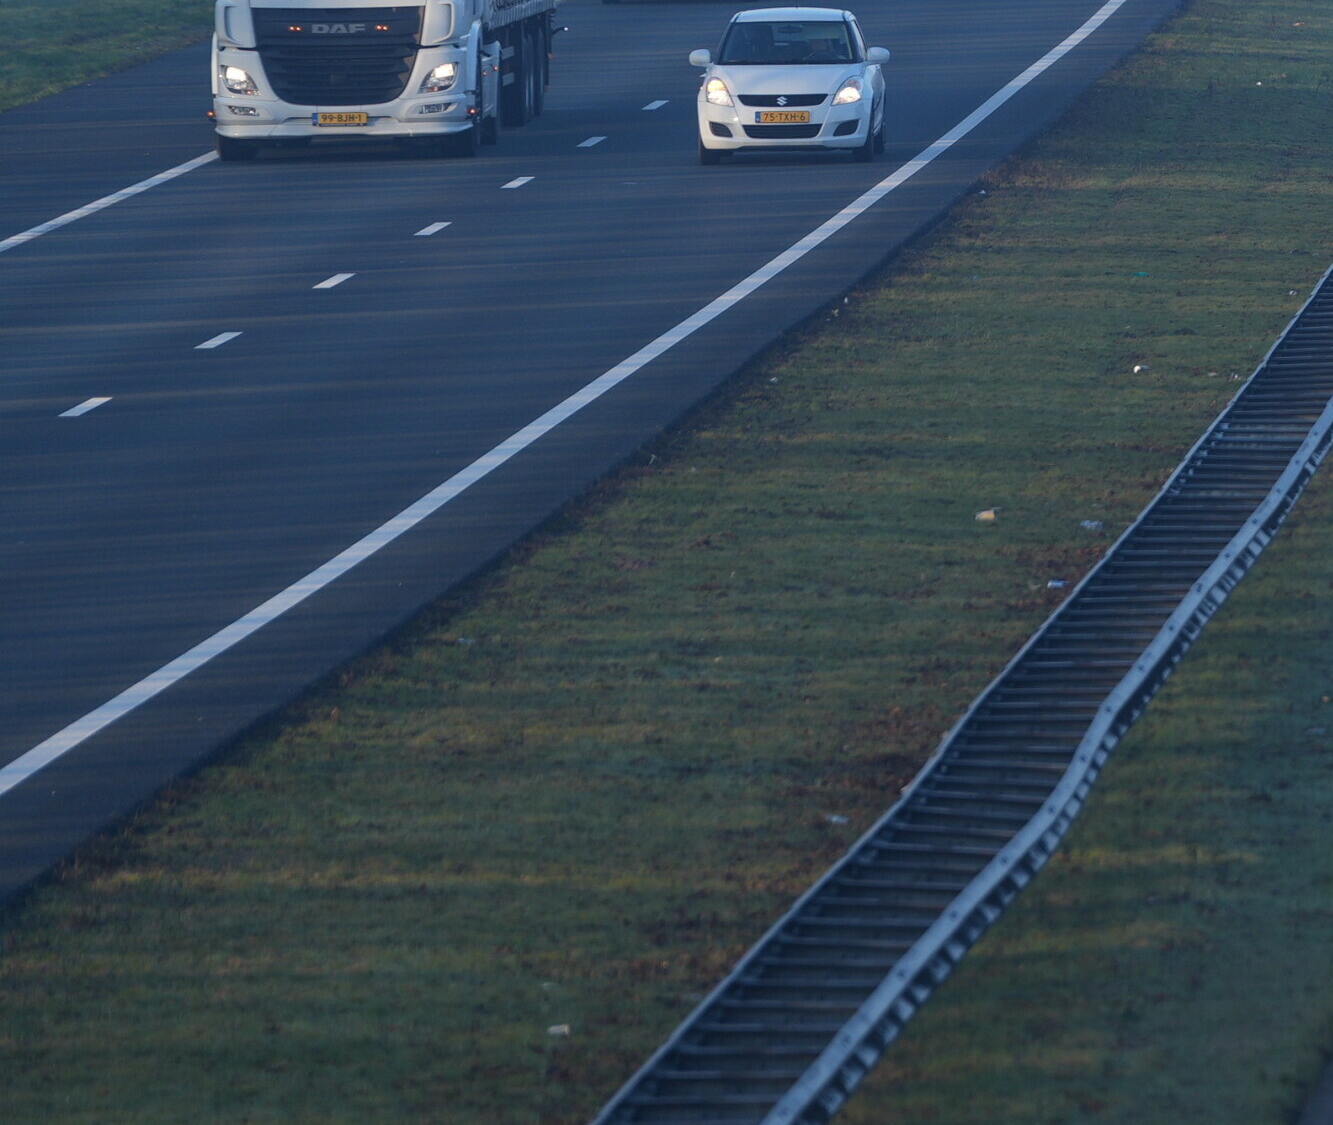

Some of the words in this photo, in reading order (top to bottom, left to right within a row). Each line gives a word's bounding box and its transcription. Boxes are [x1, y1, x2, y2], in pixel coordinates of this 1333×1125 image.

[312, 24, 365, 34] DAF
[321, 114, 362, 123] 99-BJH-1
[763, 113, 806, 122] 75-TXH-6
